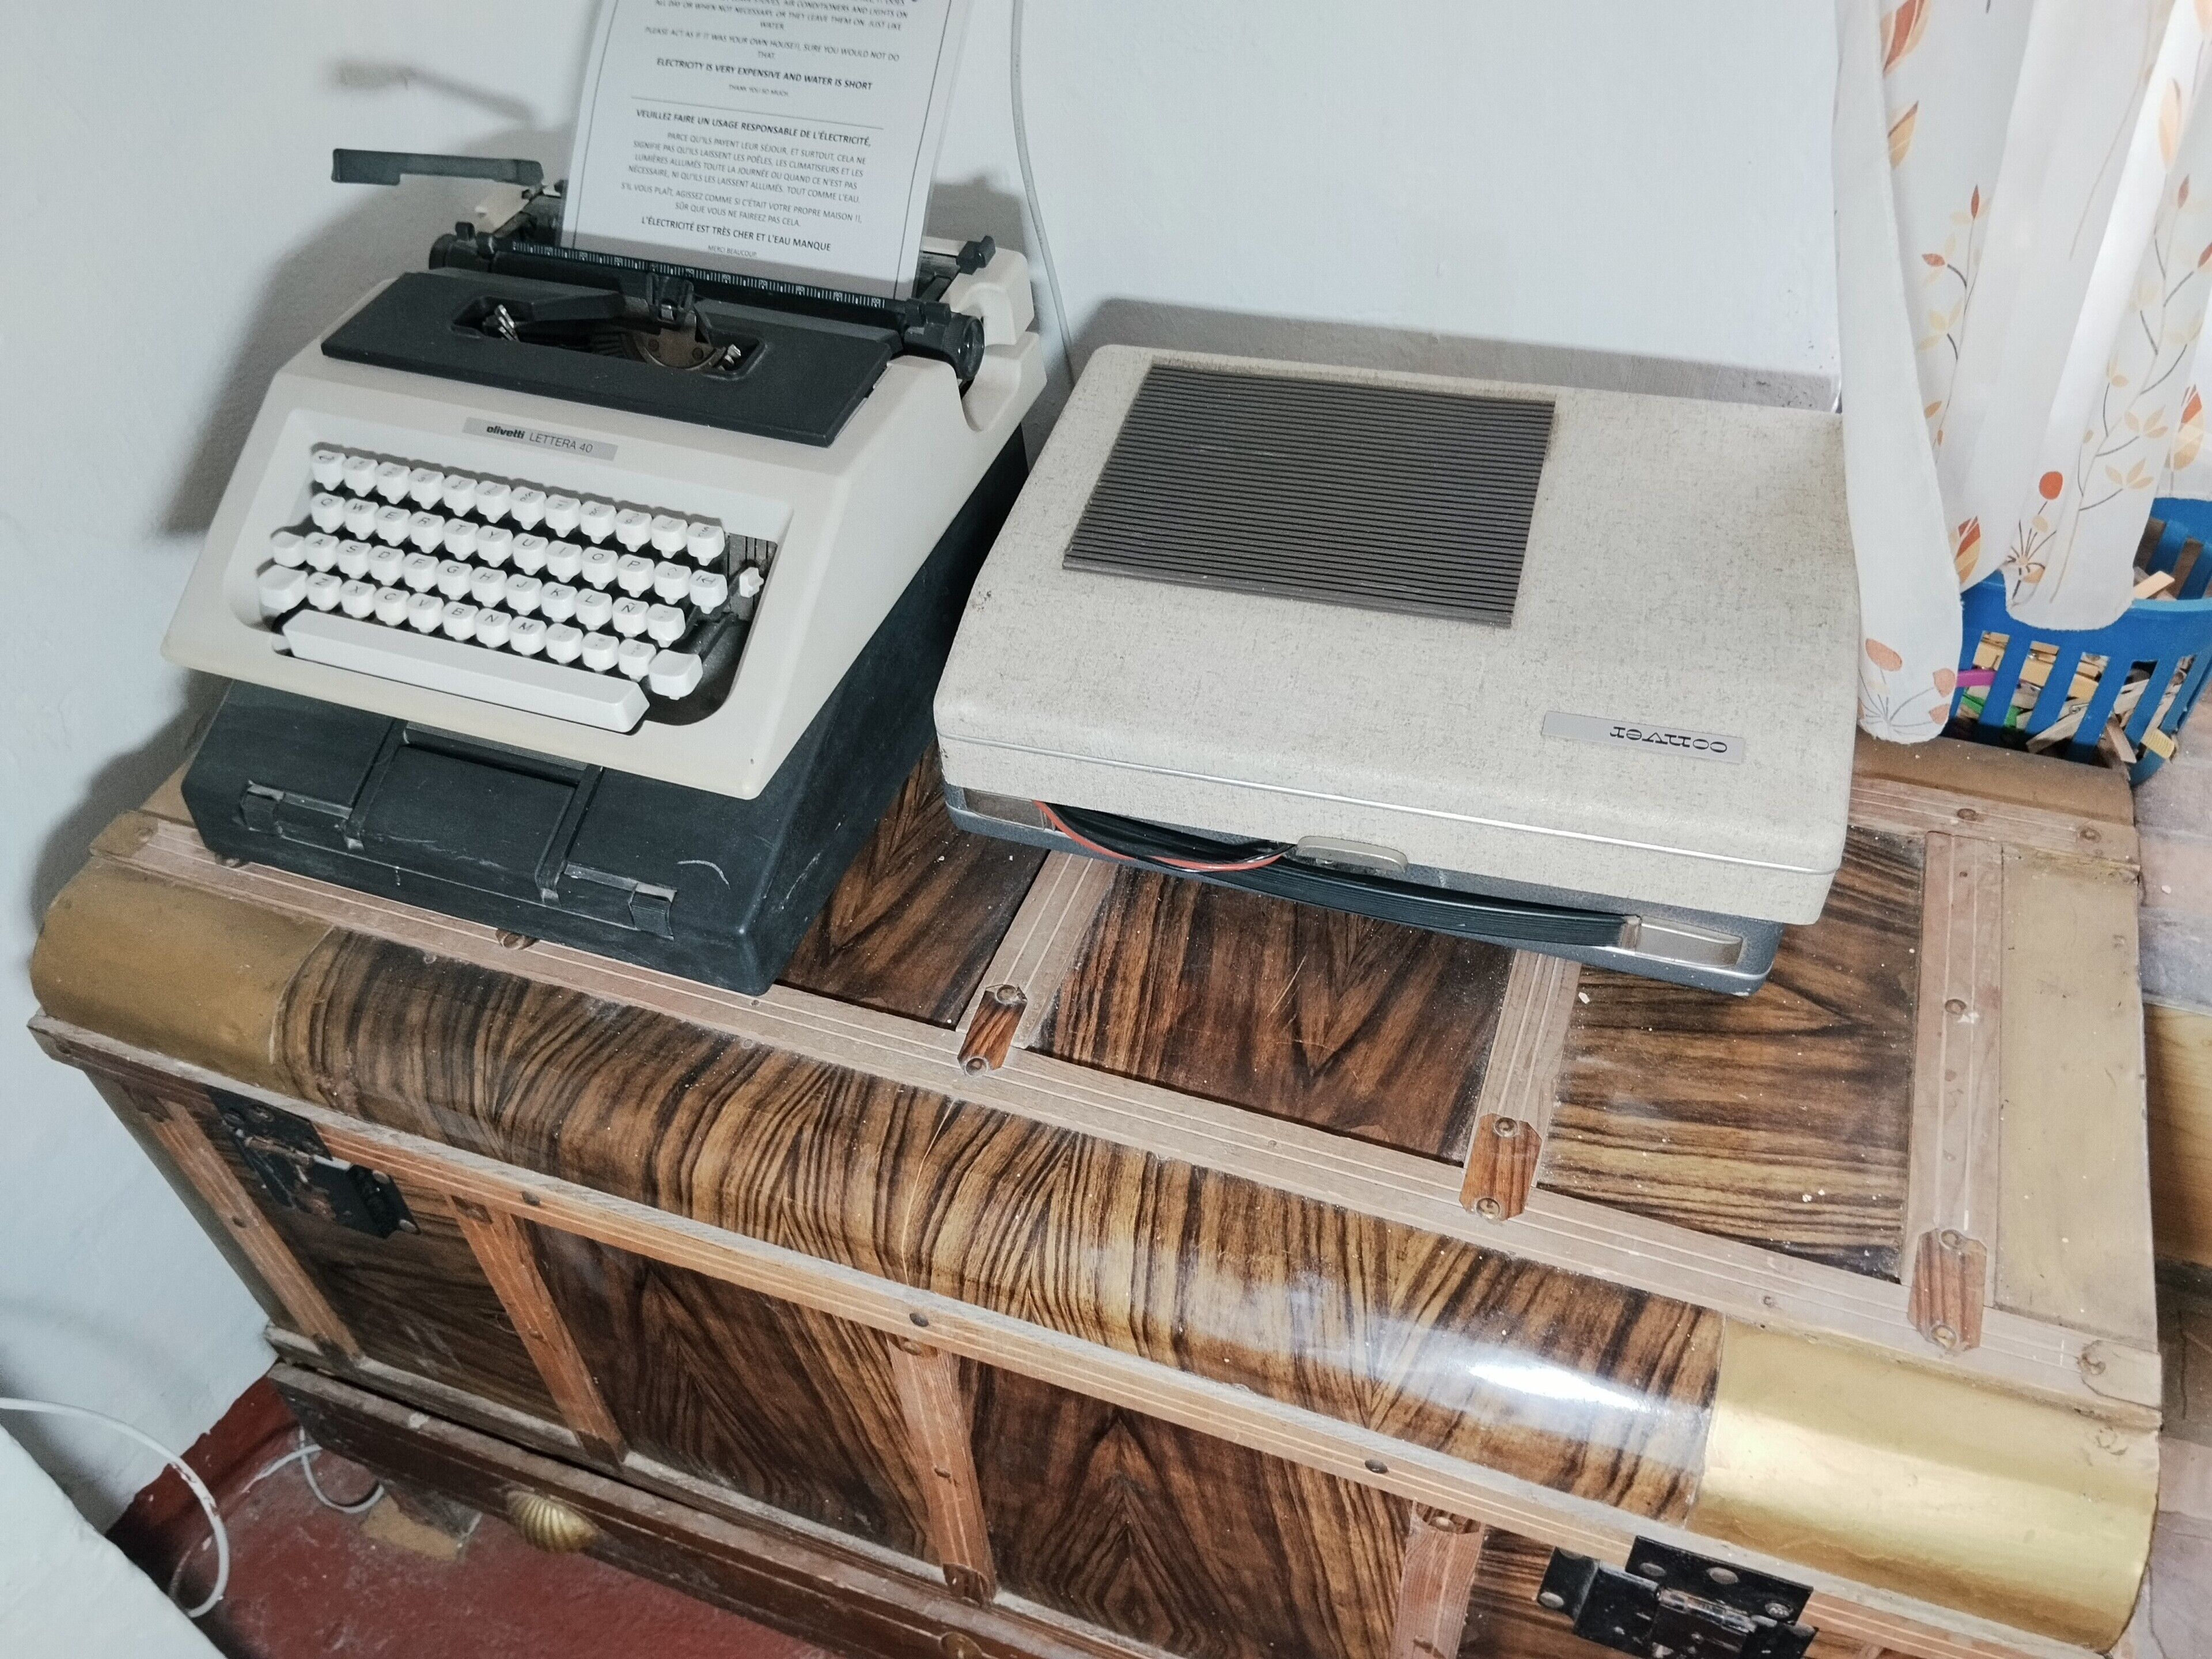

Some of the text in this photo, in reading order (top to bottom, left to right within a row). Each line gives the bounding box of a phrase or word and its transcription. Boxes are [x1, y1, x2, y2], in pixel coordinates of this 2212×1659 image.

[645, 26, 668, 35] PLEASE
[840, 48, 869, 56] WOULD
[657, 58, 703, 70] ELECTRICITY
[715, 65, 734, 73] VERY
[737, 67, 781, 78] EXPENSIVE
[783, 72, 801, 81] AND
[804, 74, 832, 85] WATER
[835, 78, 842, 86] IS
[844, 79, 873, 89] SHORT
[637, 109, 671, 120] VEUILLEZ
[674, 113, 695, 123] FAIRE
[712, 119, 738, 128] USAGE
[741, 122, 798, 135] RESPONSABLE
[813, 130, 872, 146] L'ÉLECTRICITÉ,
[634, 141, 660, 150] SIGNIFIE
[676, 146, 698, 154] QU'ILS
[701, 149, 732, 159] LAISSENT
[789, 161, 839, 173] CLIMATISEURS
[667, 132, 687, 141] PARCE
[690, 135, 712, 143] QU'ILS
[714, 138, 738, 147] PAYENT
[741, 142, 759, 150] LEUR
[837, 154, 854, 162] CELA
[671, 157, 702, 168] ALLUMÉS
[703, 162, 725, 171] TOUTE
[738, 166, 768, 176] JOURNÉE
[783, 173, 810, 183] QUAND
[823, 178, 842, 186] N'EST
[681, 172, 703, 181] QU'ILS
[718, 177, 748, 187] LAISSENT
[787, 187, 805, 195] TOUT
[808, 190, 836, 199] COMME
[675, 201, 689, 210] SÛR
[691, 204, 704, 213] QUE
[707, 207, 726, 215] VOUS
[676, 190, 703, 199] AGISSEZ
[705, 194, 732, 203] COMME
[768, 203, 791, 211] VOTRE
[793, 206, 821, 215] PROPRE
[823, 210, 853, 219] MAISON
[642, 215, 695, 230] L'ÉLECTRICITÉ
[696, 224, 710, 232] EST
[712, 225, 731, 236] TRÈS
[733, 229, 754, 238] CHER
[768, 234, 790, 244] L'EAU
[793, 238, 831, 251] MANQUE
[486, 425, 593, 453] olivetti LETTERA 40
[522, 539, 535, 547] U
[592, 553, 604, 561] O
[346, 545, 358, 553] S
[480, 573, 493, 581] H
[585, 594, 593, 603] L
[452, 607, 465, 616] B
[484, 614, 499, 622] N
[520, 622, 535, 631] M
[1609, 726, 1728, 753] conver
